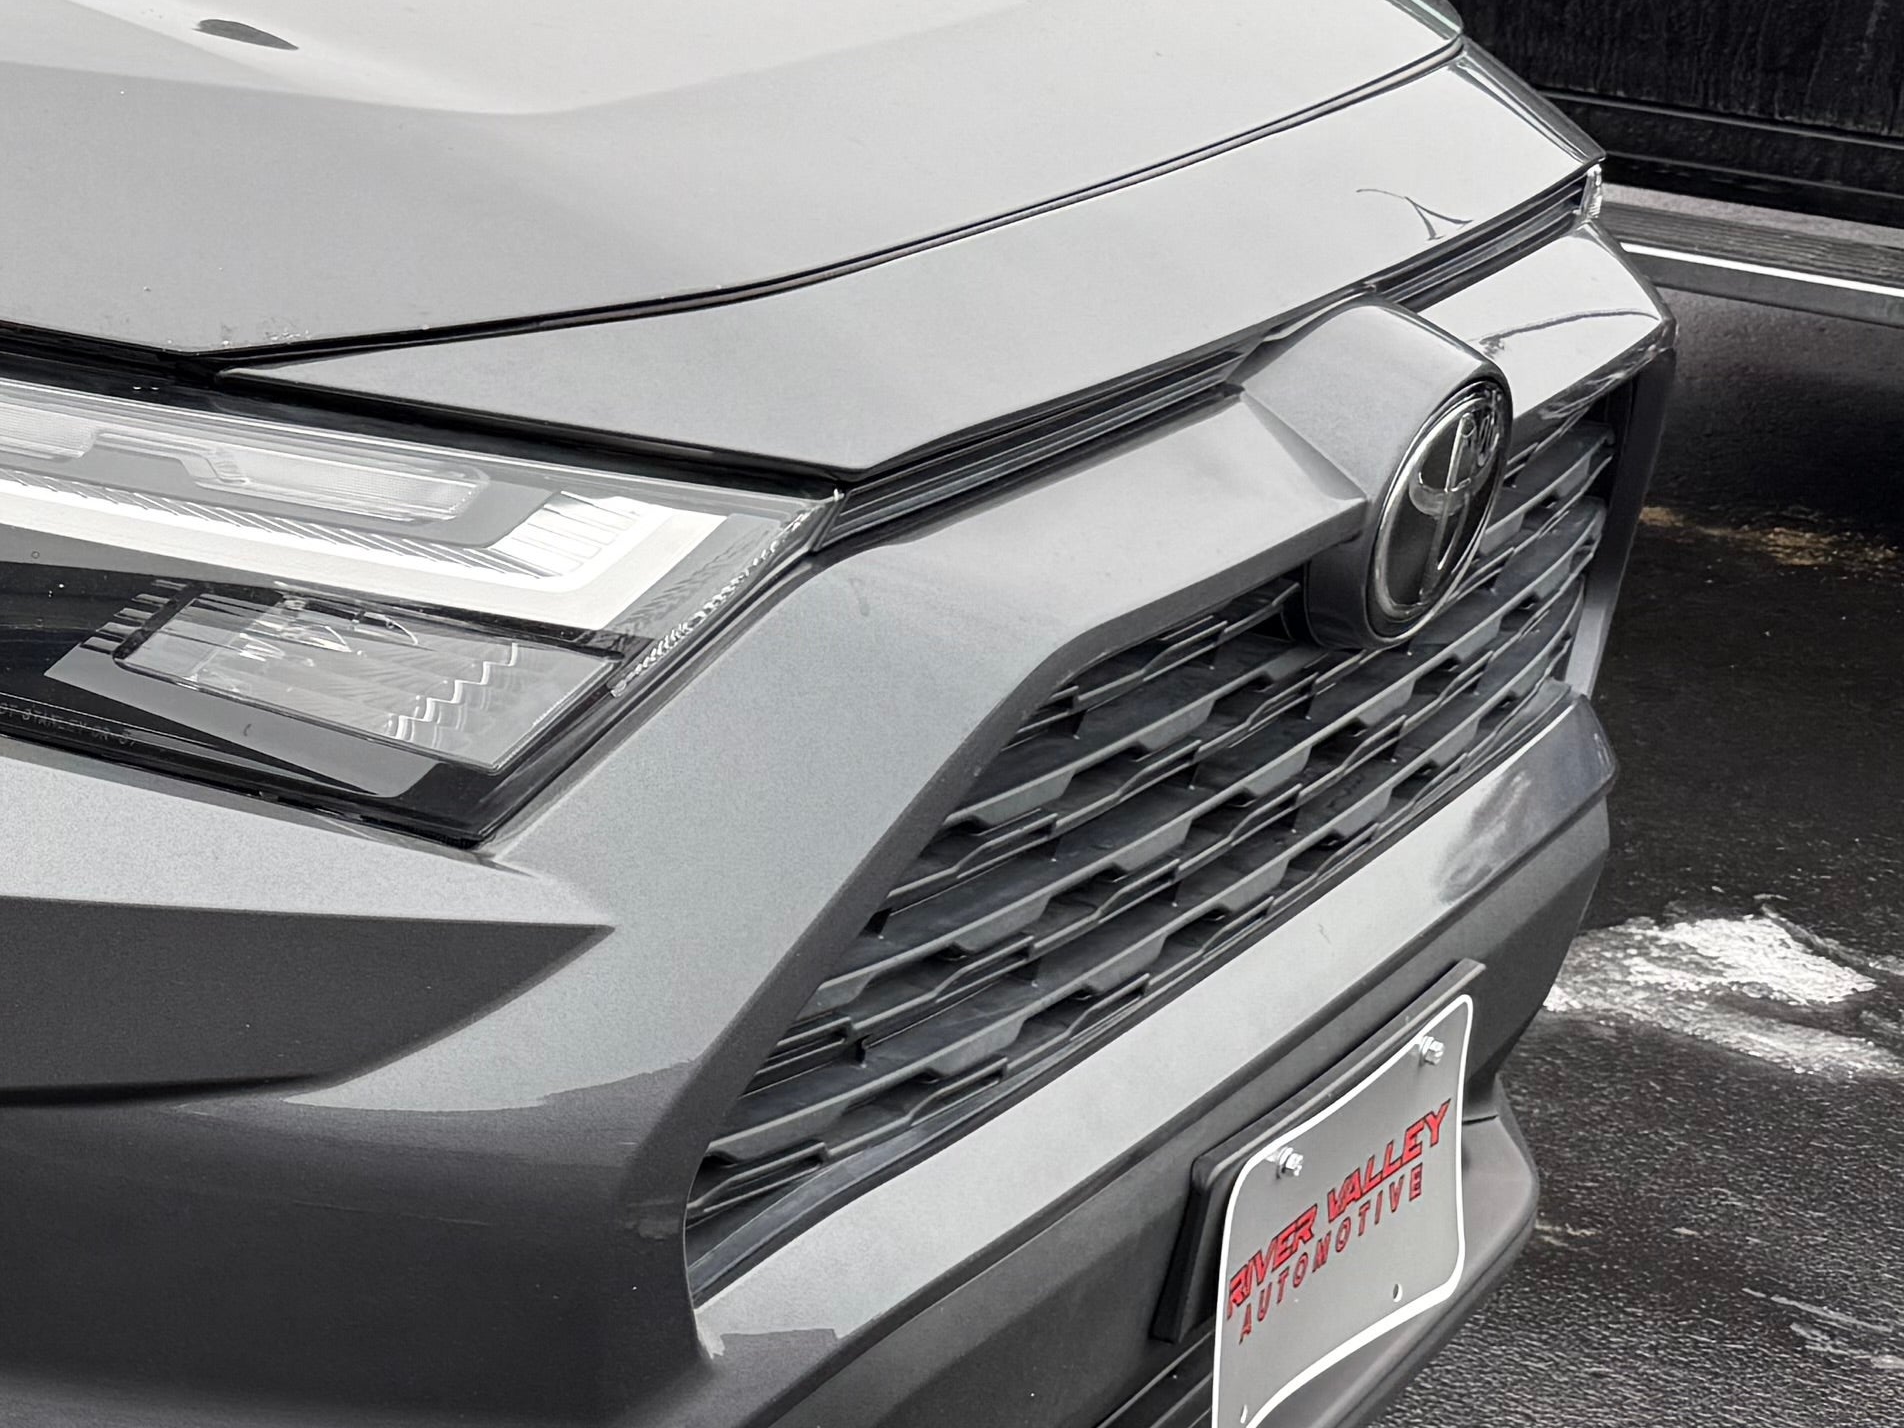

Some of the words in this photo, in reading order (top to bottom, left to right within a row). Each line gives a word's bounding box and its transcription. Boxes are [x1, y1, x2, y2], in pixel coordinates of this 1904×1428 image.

[1226, 1203, 1318, 1321] RIVER
[1326, 1097, 1452, 1222] VALLEY
[1238, 1161, 1424, 1345] AUTOMOTIVE
